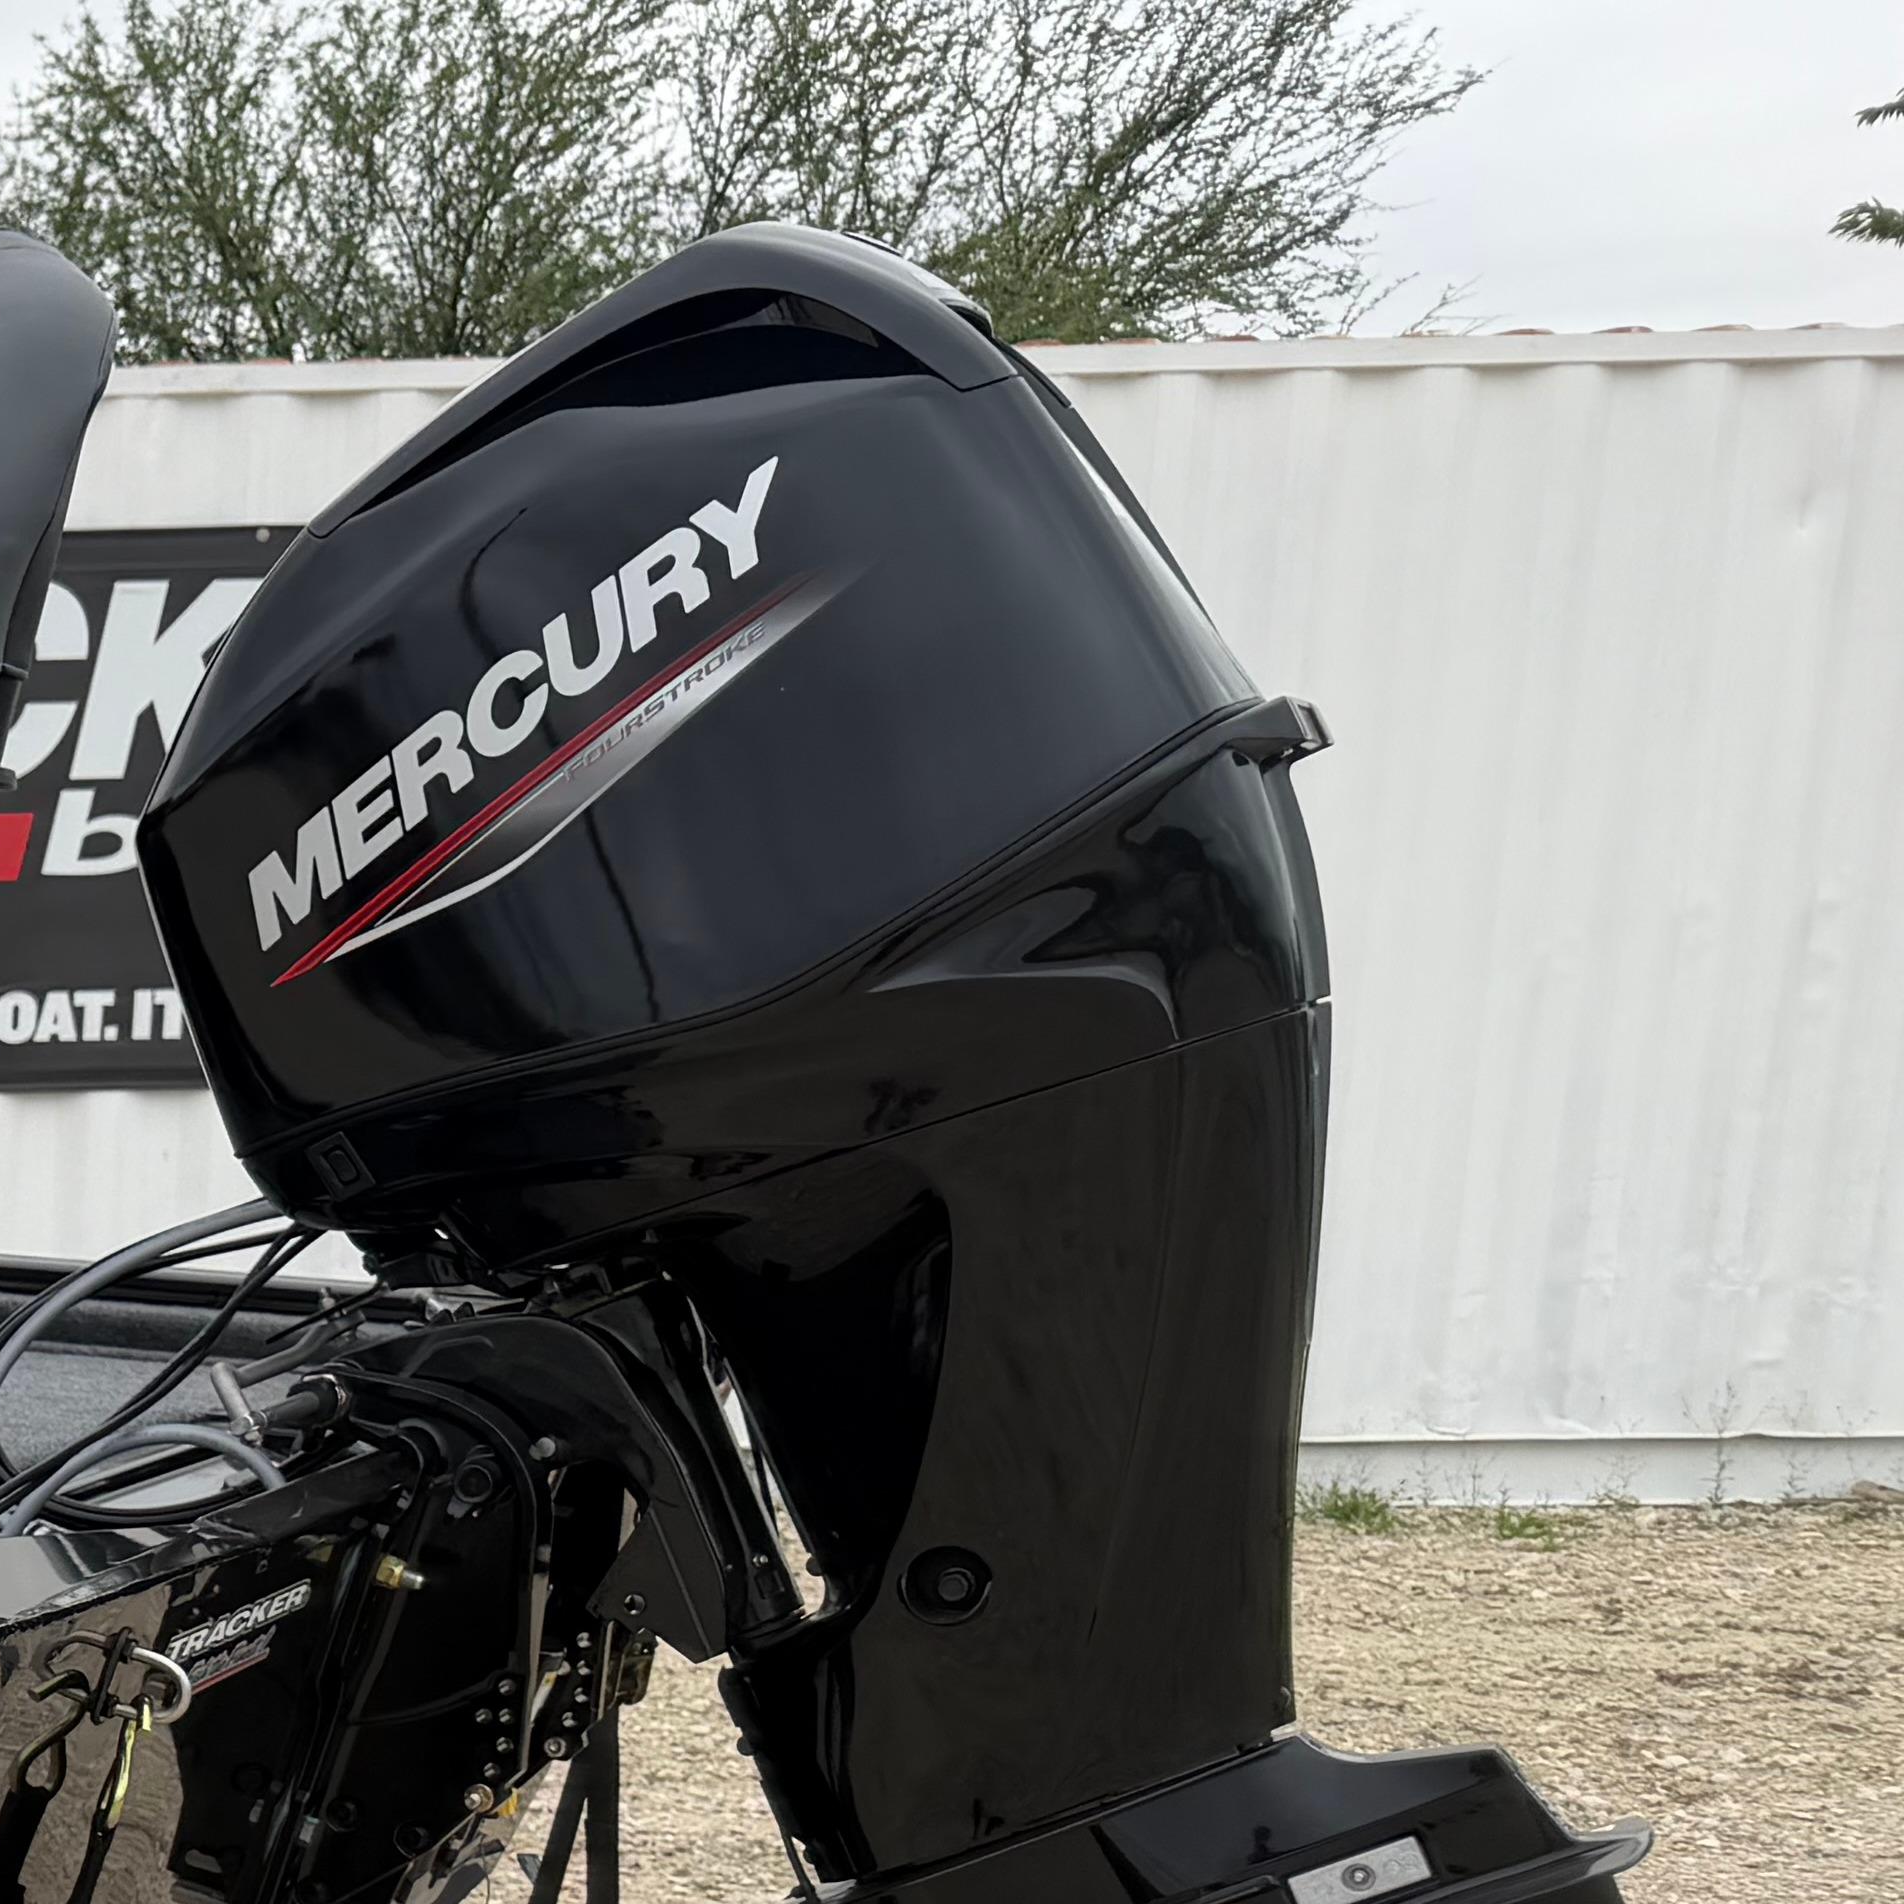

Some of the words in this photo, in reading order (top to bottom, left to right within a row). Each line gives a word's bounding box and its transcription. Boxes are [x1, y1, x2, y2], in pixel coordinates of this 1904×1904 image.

[248, 455, 779, 952] MERCURY
[563, 620, 767, 783] FOURSTROKE
[165, 1582, 311, 1662] TRACKER
